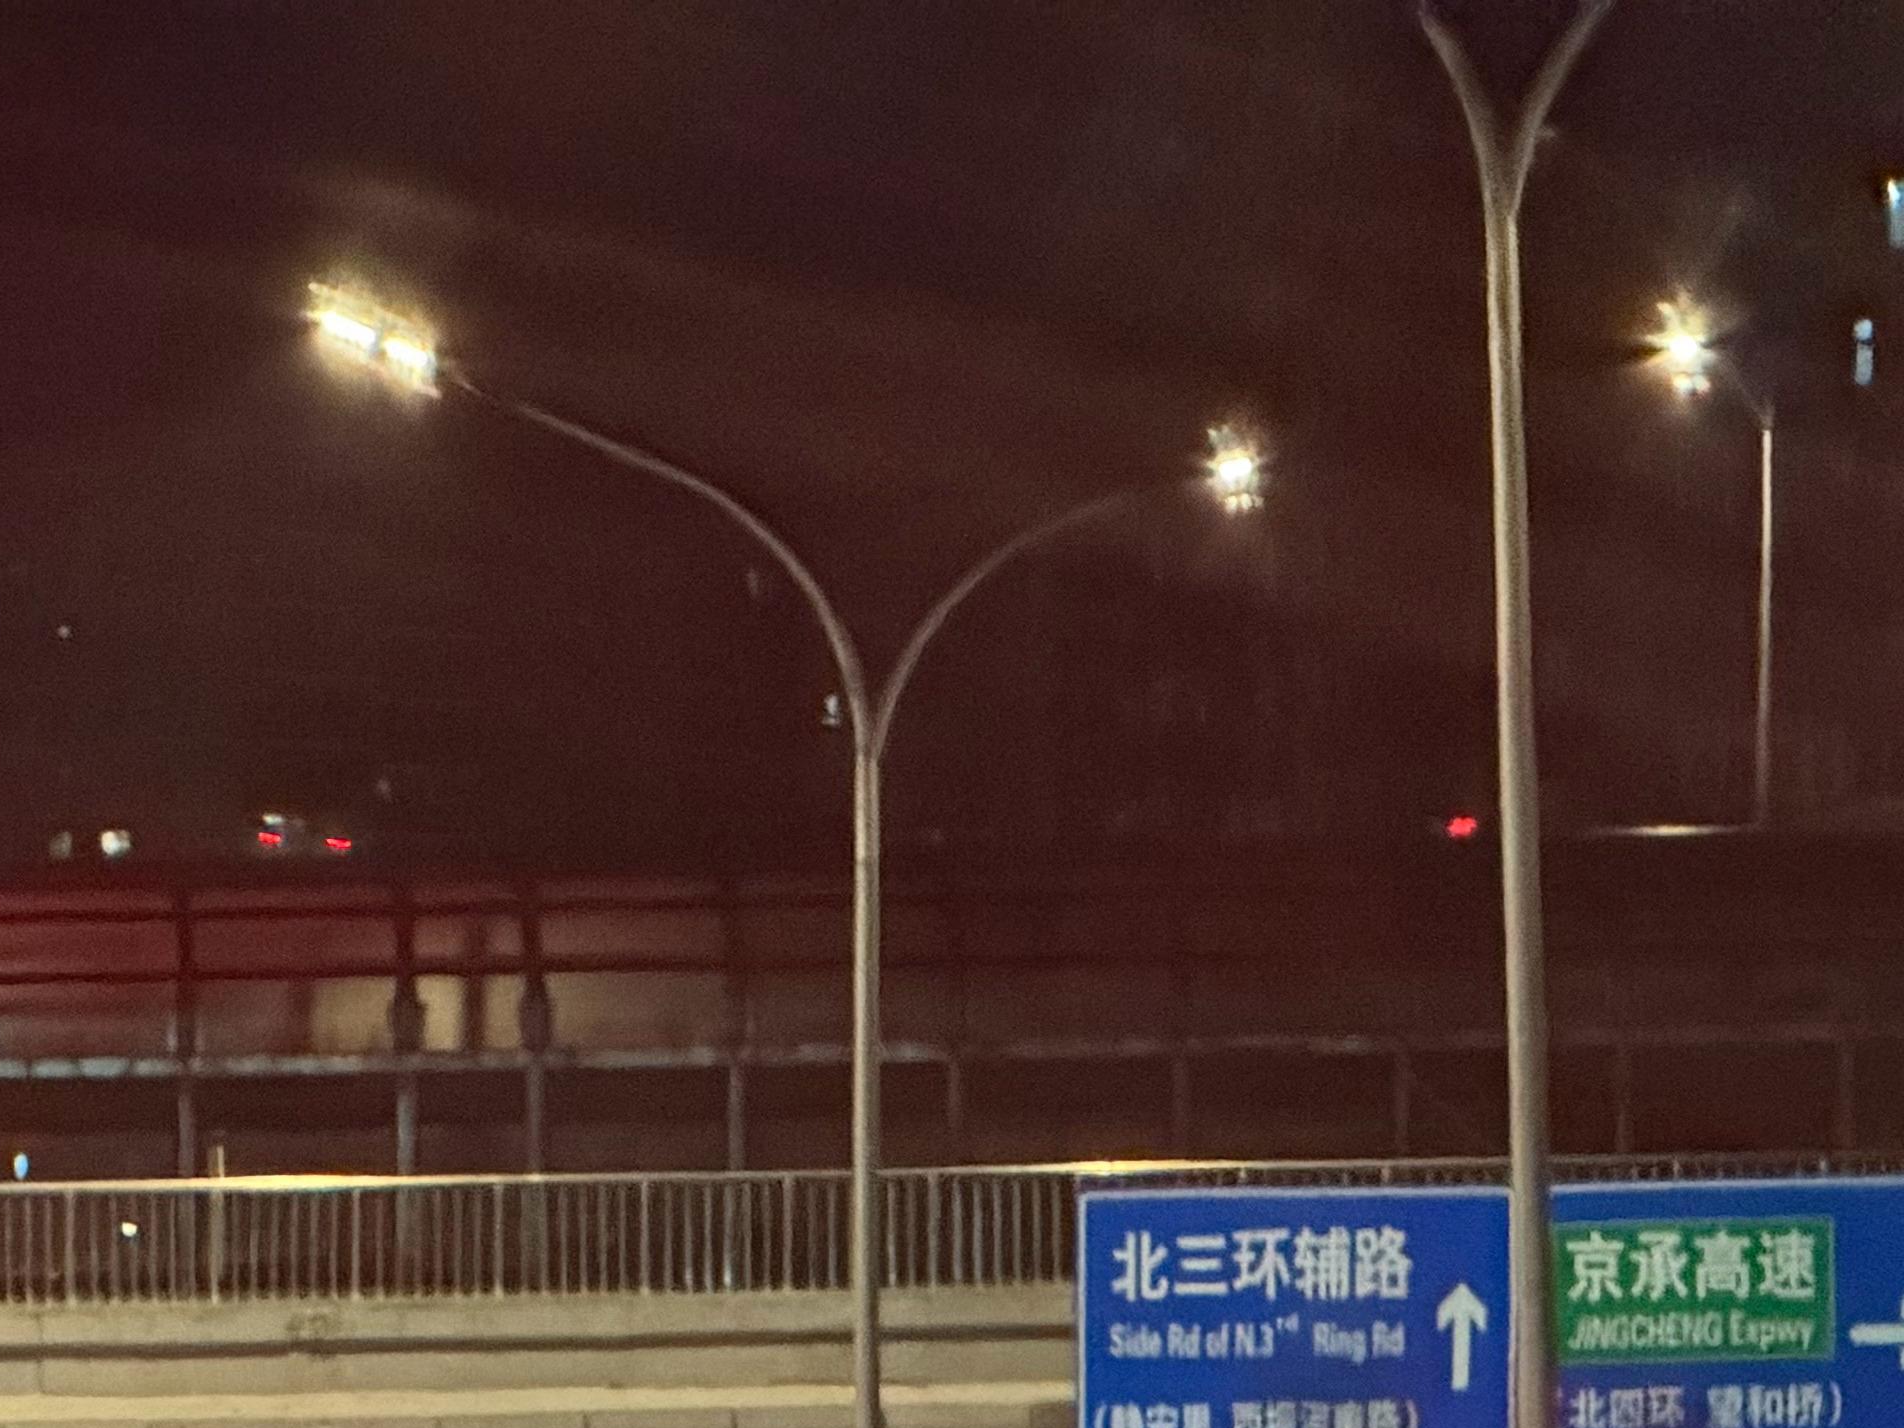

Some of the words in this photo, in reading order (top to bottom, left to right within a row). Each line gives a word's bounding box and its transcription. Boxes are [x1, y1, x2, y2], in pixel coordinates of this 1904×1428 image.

[1111, 1225, 1413, 1302] 北三环辅路
[1566, 1228, 1816, 1302] 京承高速
[1109, 1322, 1163, 1359] Side
[1167, 1322, 1201, 1359] Rd
[1206, 1322, 1229, 1359] of
[1313, 1320, 1367, 1366] Ring
[1371, 1320, 1406, 1358] Rd
[1568, 1310, 1724, 1351] JINGCHENG
[1729, 1307, 1815, 1352] Expwy
